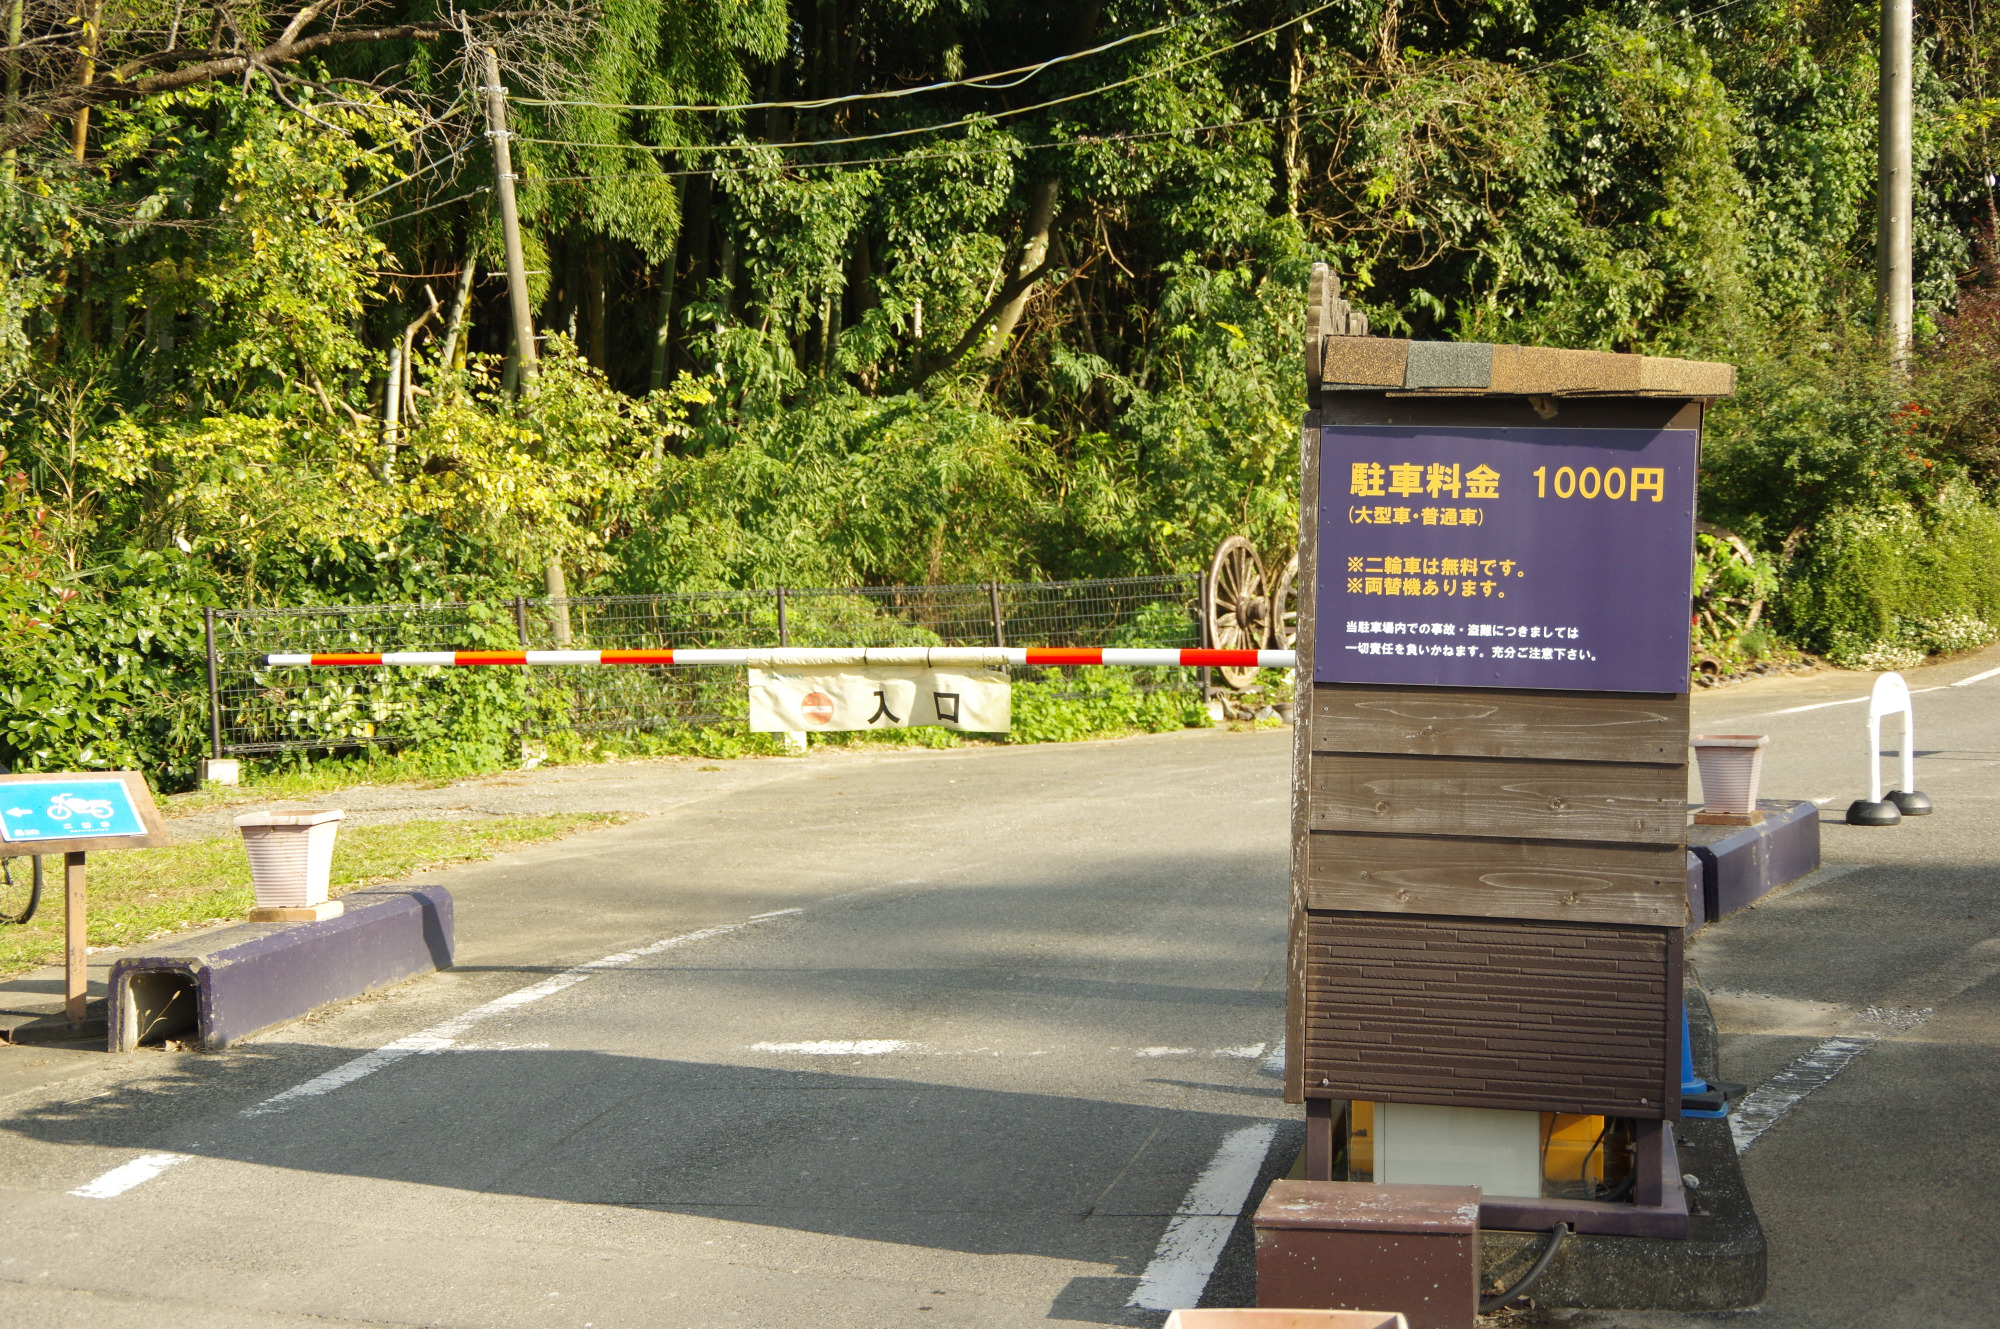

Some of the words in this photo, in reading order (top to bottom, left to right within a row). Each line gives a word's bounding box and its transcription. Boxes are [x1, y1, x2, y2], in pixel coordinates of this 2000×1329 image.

[1350, 462, 1500, 498] 駐車料金
[1533, 466, 1665, 502] 1000円
[1349, 505, 1484, 526] （大型車・普通車）
[1347, 556, 1524, 578] ※二輪車は無料です。
[1347, 577, 1505, 598] ※両替機あります。
[1346, 621, 1579, 639] 当駐車場内での事故・盗難につきましては
[867, 691, 960, 724] 入口
